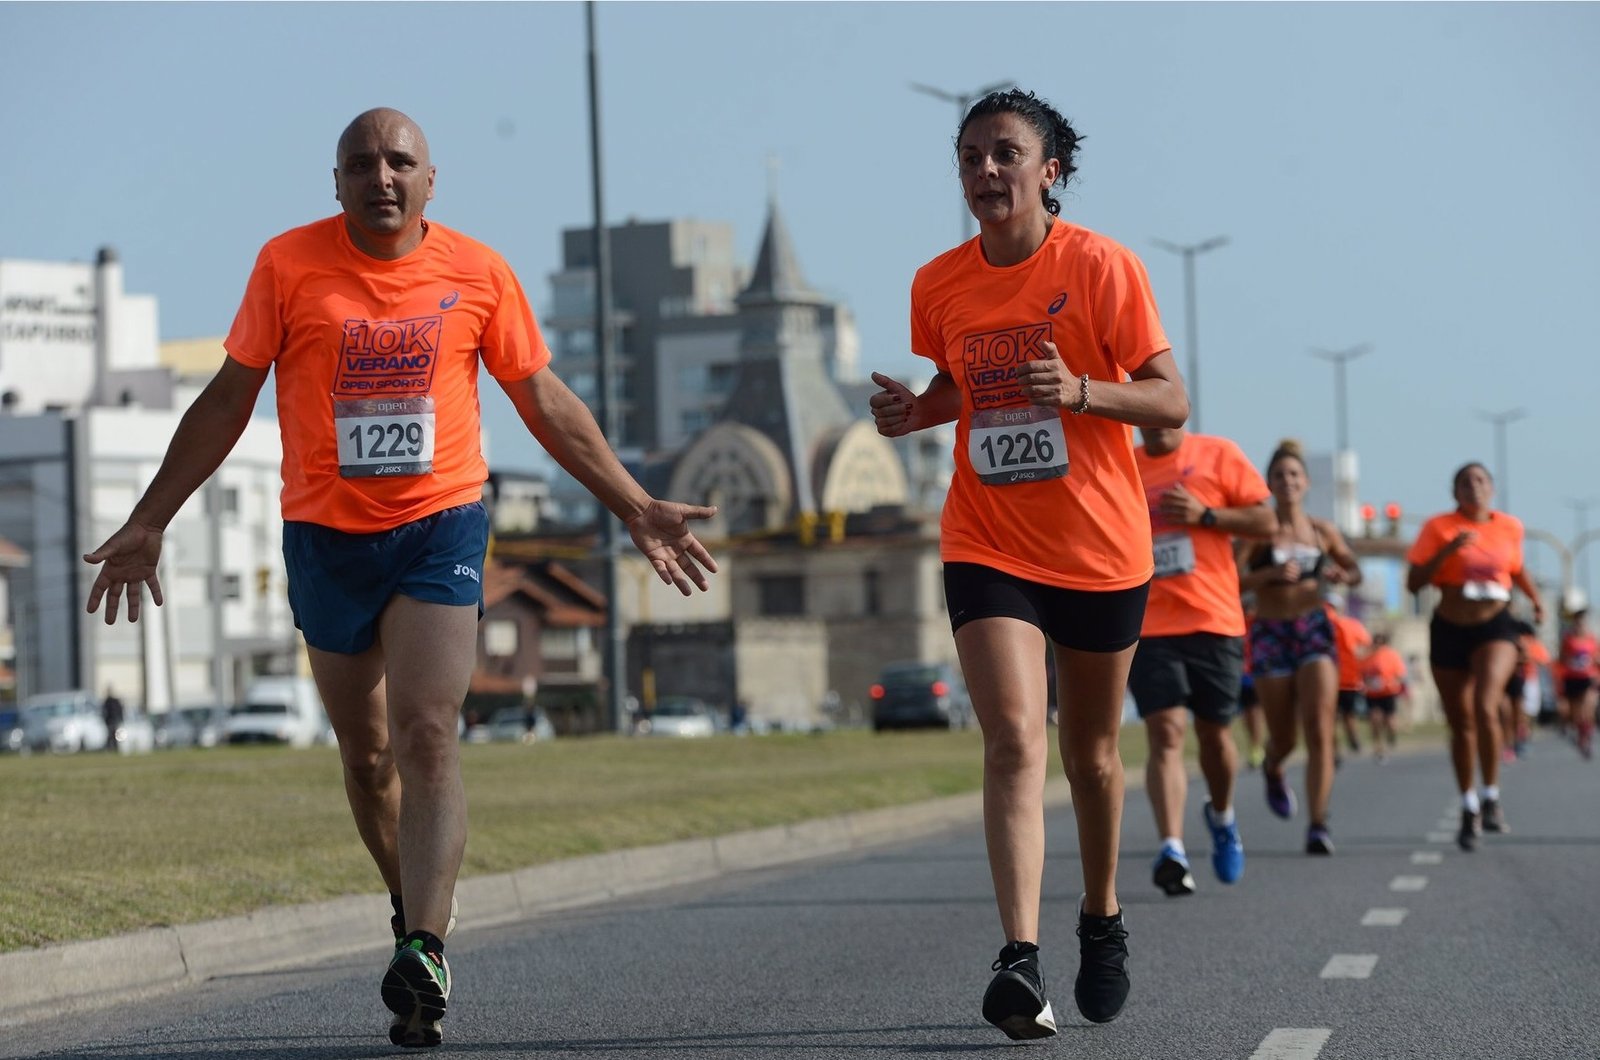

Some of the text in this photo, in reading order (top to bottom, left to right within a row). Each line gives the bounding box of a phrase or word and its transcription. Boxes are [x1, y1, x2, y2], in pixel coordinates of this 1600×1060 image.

[346, 320, 437, 356] 10K
[967, 327, 1047, 371] 10K
[346, 354, 431, 371] VERANO
[340, 378, 426, 390] OPEN SPORTS
[970, 366, 1018, 386] VERA
[377, 402, 407, 412] open
[1004, 411, 1032, 422] open
[349, 422, 424, 459] 1229
[980, 429, 1054, 468] 1226
